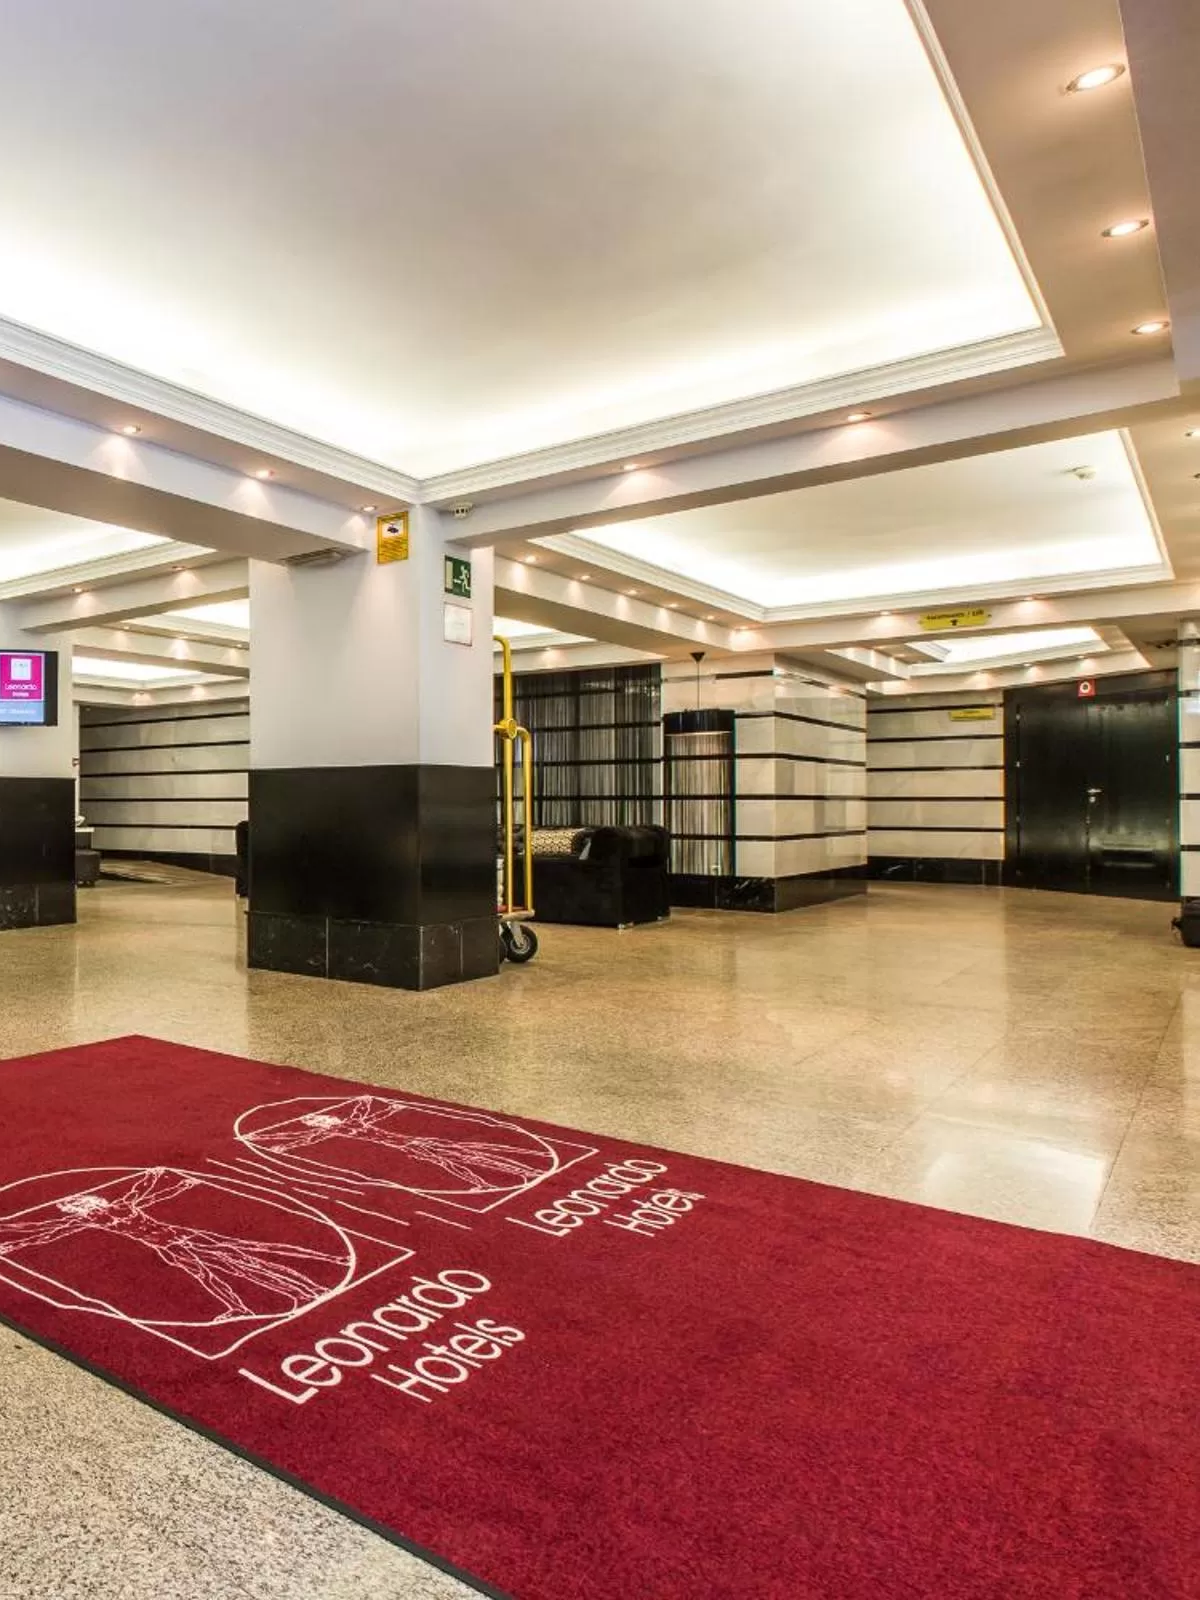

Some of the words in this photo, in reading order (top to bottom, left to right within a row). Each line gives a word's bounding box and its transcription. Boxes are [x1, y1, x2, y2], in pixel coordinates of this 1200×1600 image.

[504, 1159, 668, 1237] Leonardo
[238, 1269, 492, 1404] Leonardo
[370, 1319, 526, 1403] Hotels
